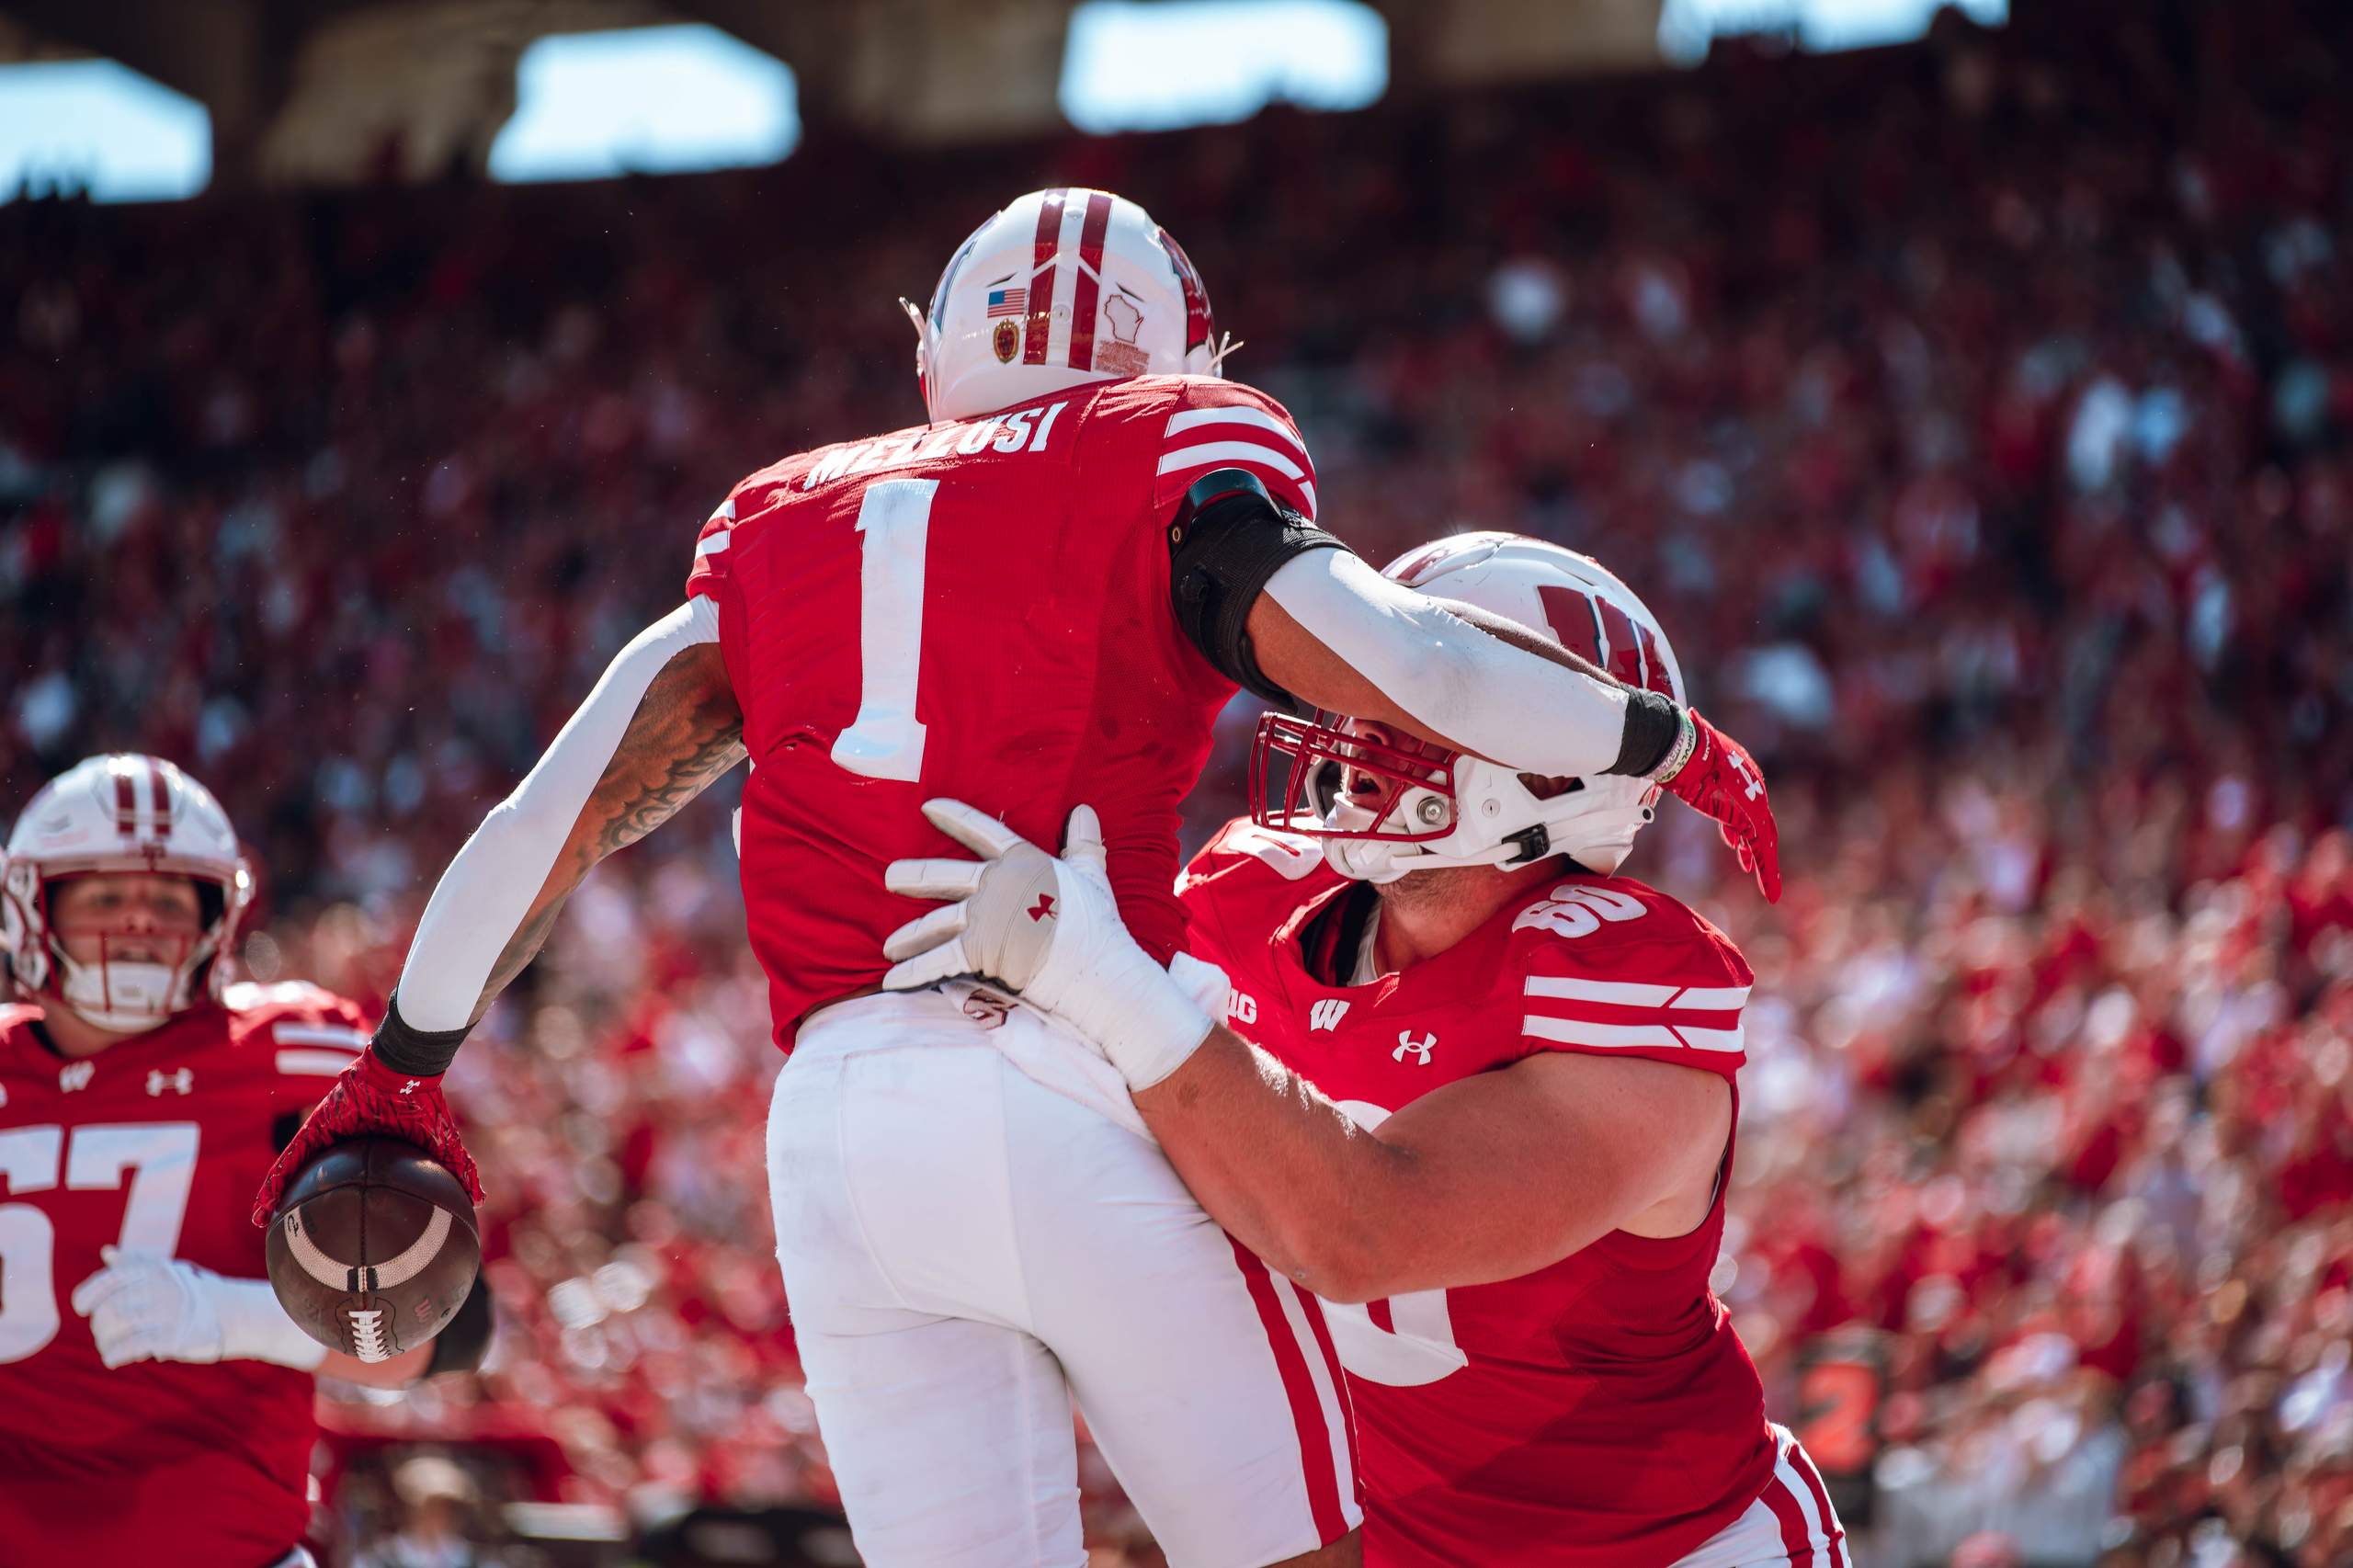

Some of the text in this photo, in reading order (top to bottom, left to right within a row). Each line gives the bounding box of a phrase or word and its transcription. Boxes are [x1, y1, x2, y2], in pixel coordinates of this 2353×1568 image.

[802, 401, 1069, 491] MELLUSI
[831, 479, 940, 783] 1
[1511, 884, 1648, 939] 80
[1310, 999, 1351, 1033] W
